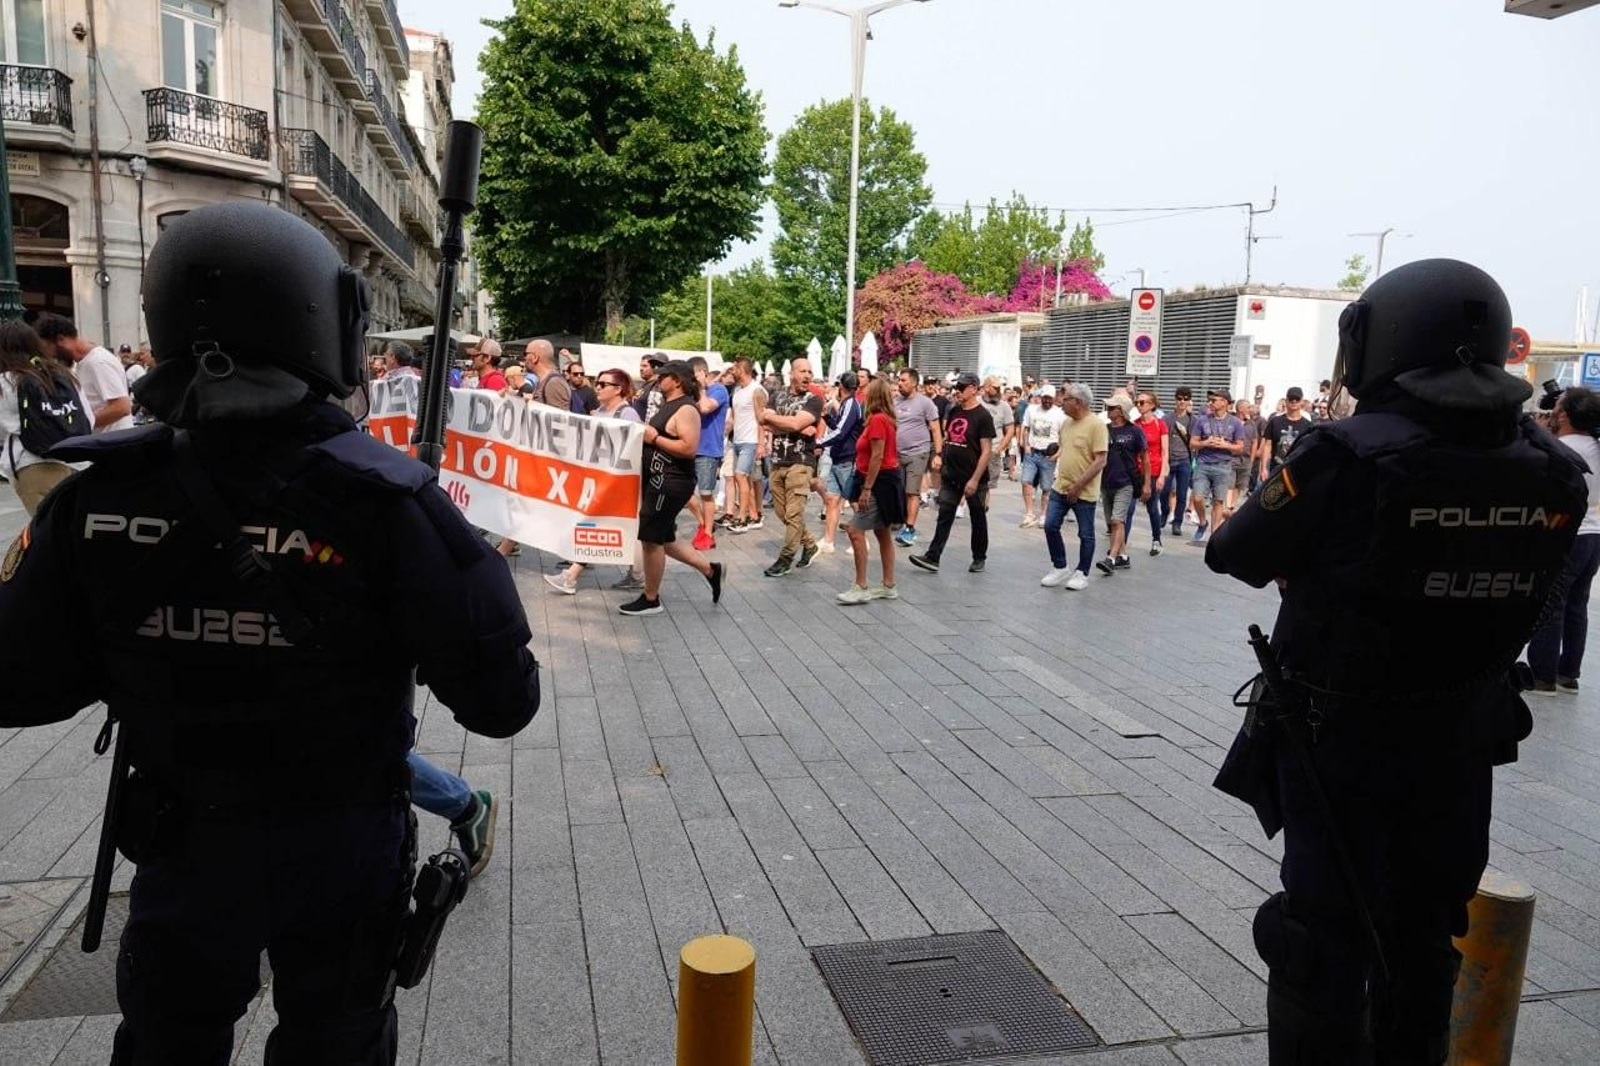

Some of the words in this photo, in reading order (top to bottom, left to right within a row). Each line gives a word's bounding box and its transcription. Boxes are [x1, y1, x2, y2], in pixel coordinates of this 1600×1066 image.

[546, 466, 597, 512] XA
[1409, 506, 1549, 528] POLICIA
[576, 529, 620, 545] CCOO
[575, 546, 623, 558] industria
